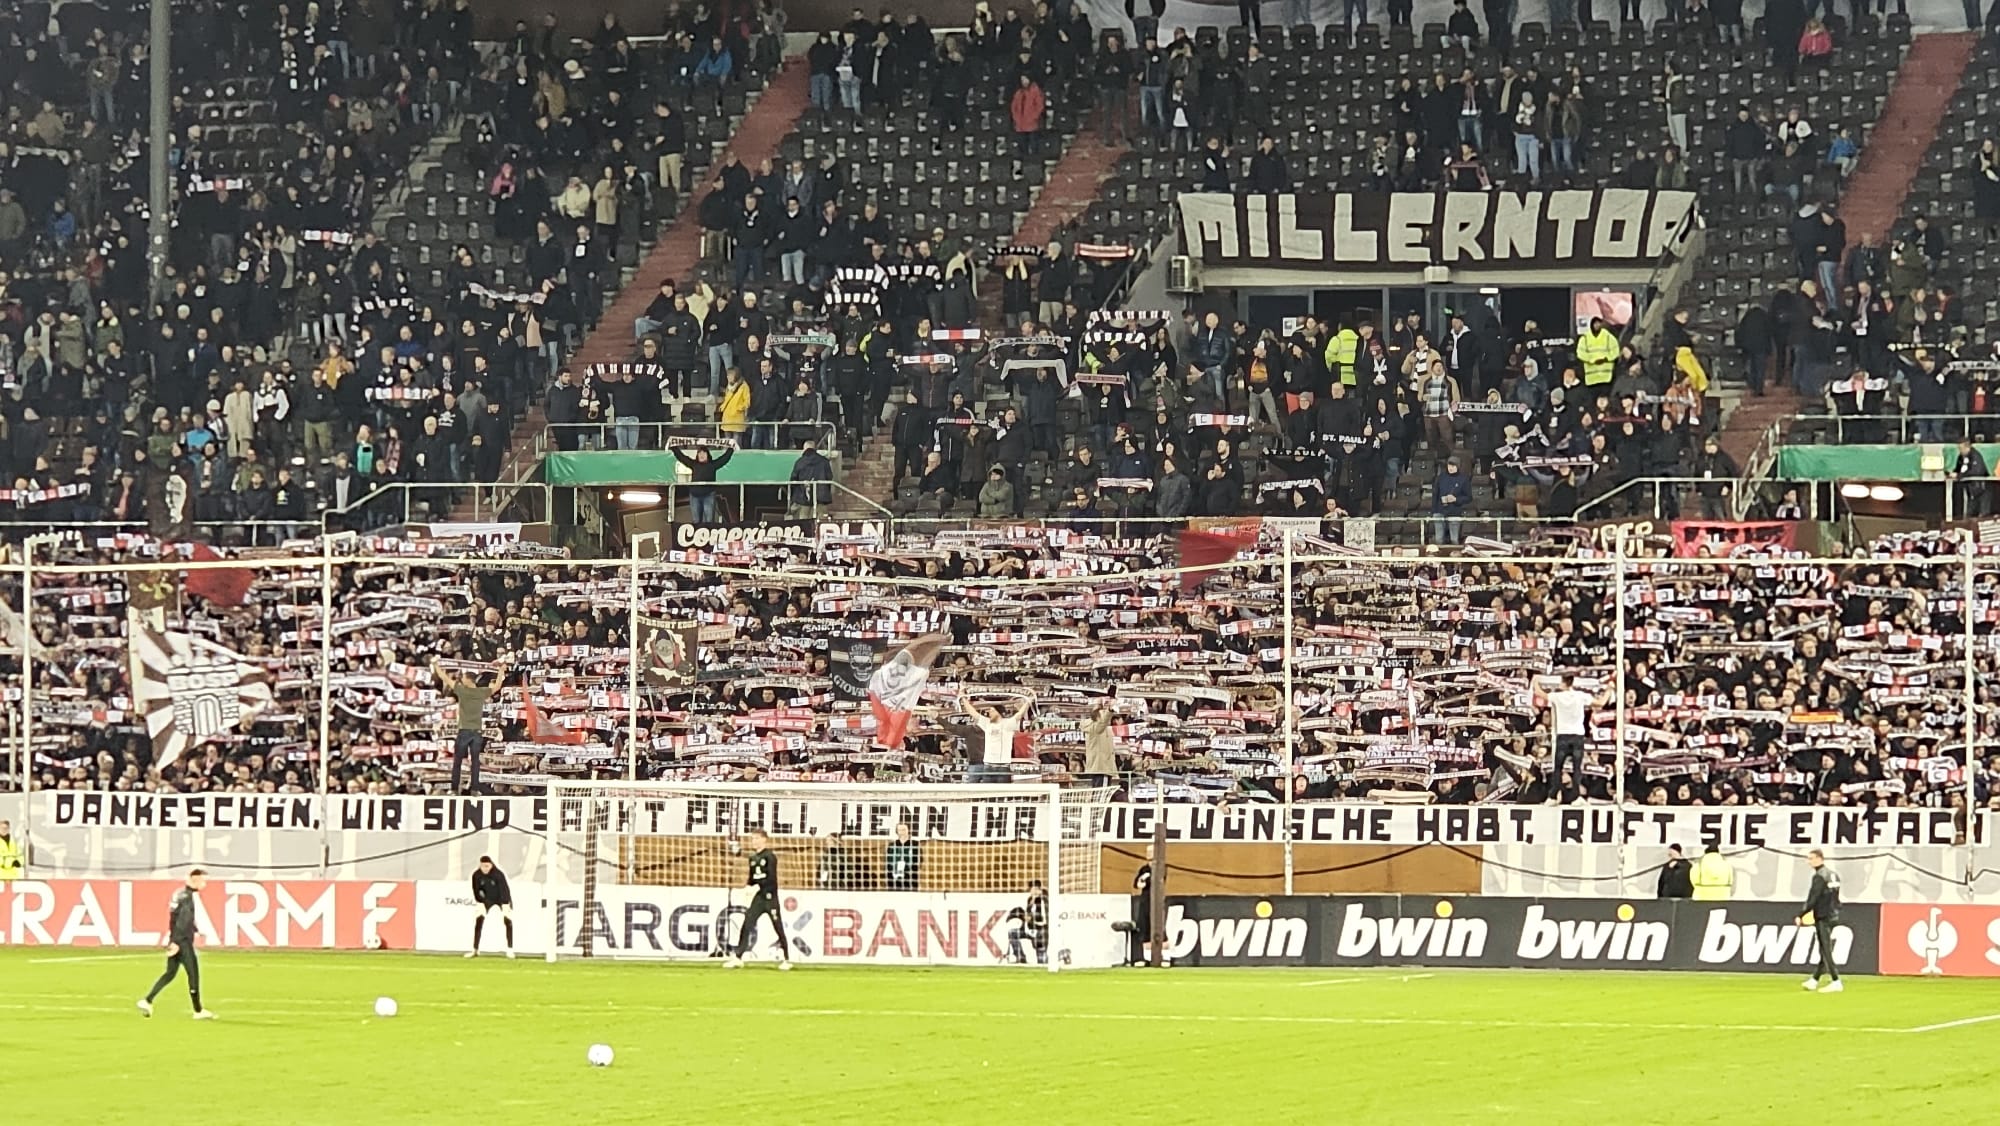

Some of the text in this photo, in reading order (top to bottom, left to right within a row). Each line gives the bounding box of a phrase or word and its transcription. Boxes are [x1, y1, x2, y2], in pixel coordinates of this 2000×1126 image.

[1177, 189, 1696, 262] MILLERNTOR
[56, 794, 320, 830] DANKESCHÖN,
[342, 797, 402, 831] WIR
[424, 799, 511, 831] SIND
[533, 799, 666, 833] SANKT
[686, 800, 817, 836] PAULI,
[841, 803, 949, 838] WENN
[970, 806, 1037, 839] IHR
[1417, 808, 1533, 844] HABT,
[1561, 810, 1674, 843] RUFT
[1700, 813, 1767, 845] SIE
[0, 881, 335, 947] RALARM
[823, 908, 1006, 958] BANK
[1164, 901, 1308, 958] bwin
[1336, 901, 1489, 958] bwin
[1516, 904, 1670, 962] bwin
